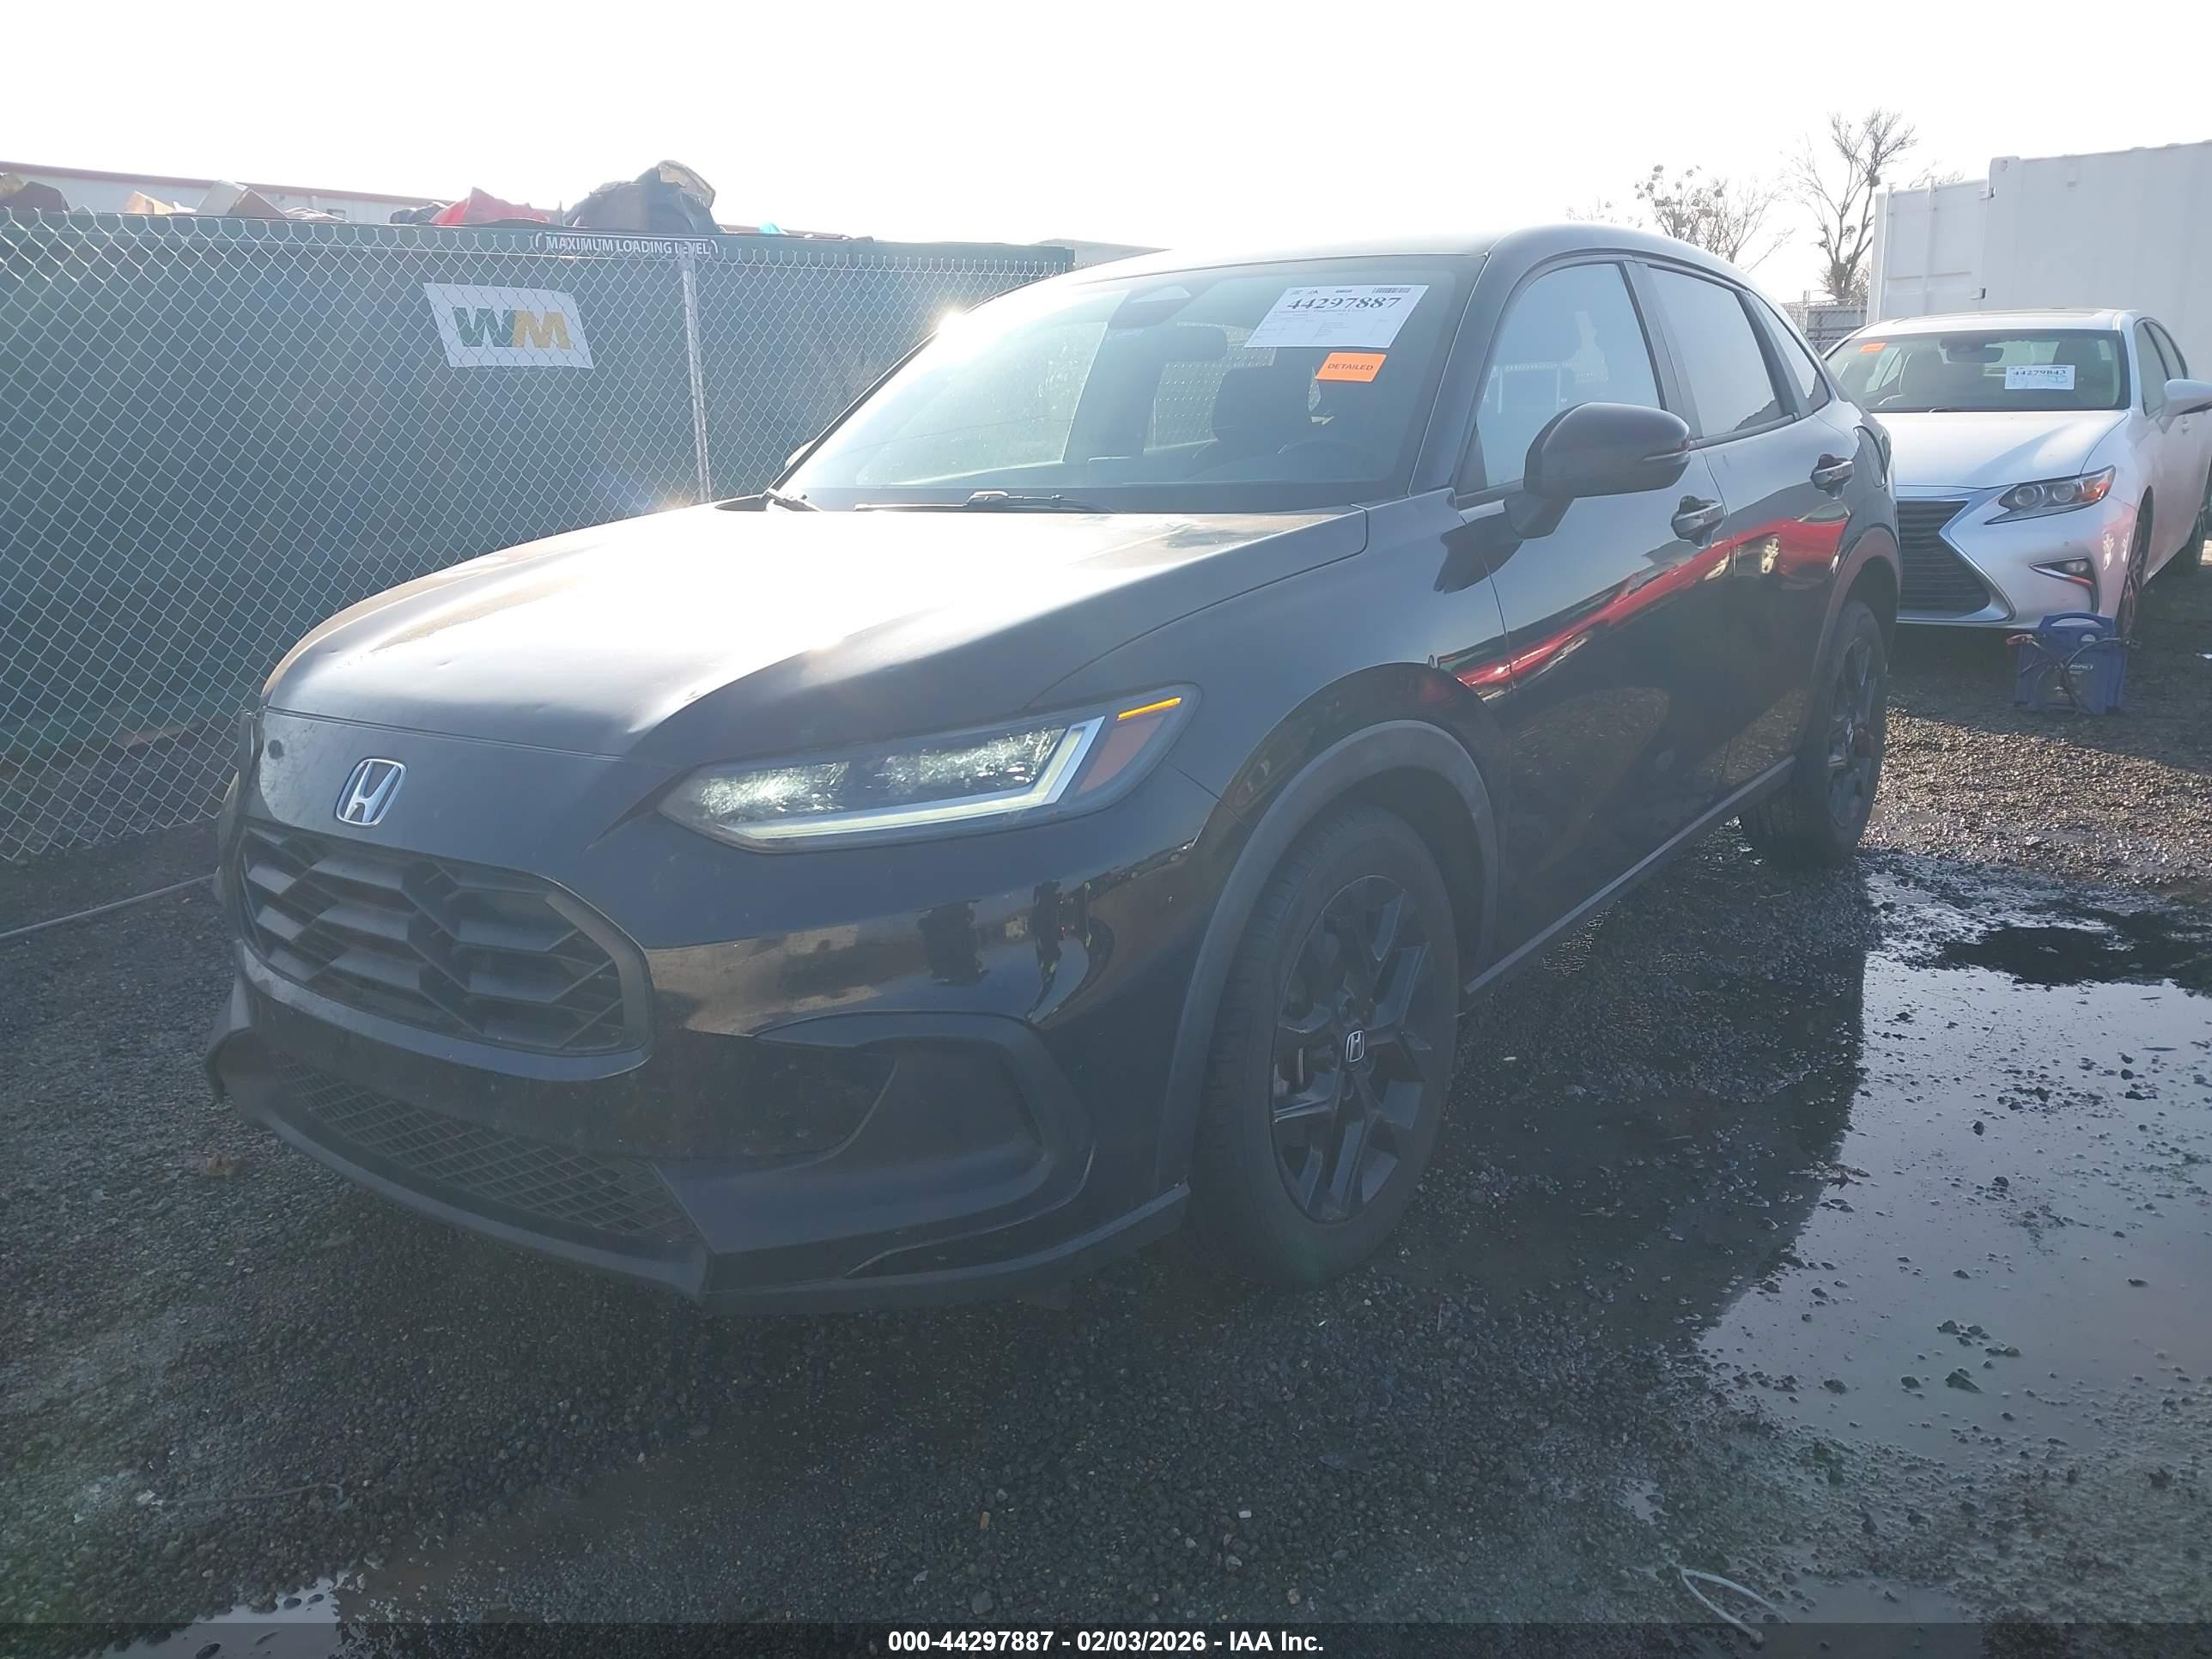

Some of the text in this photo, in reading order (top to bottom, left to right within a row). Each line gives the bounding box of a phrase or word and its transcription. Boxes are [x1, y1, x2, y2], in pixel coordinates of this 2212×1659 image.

[545, 236, 711, 255] MAXIMUM LOADING LEVEL
[1286, 296, 1402, 309] 44297887
[452, 306, 573, 350] WM
[1327, 362, 1374, 371] DETAILED
